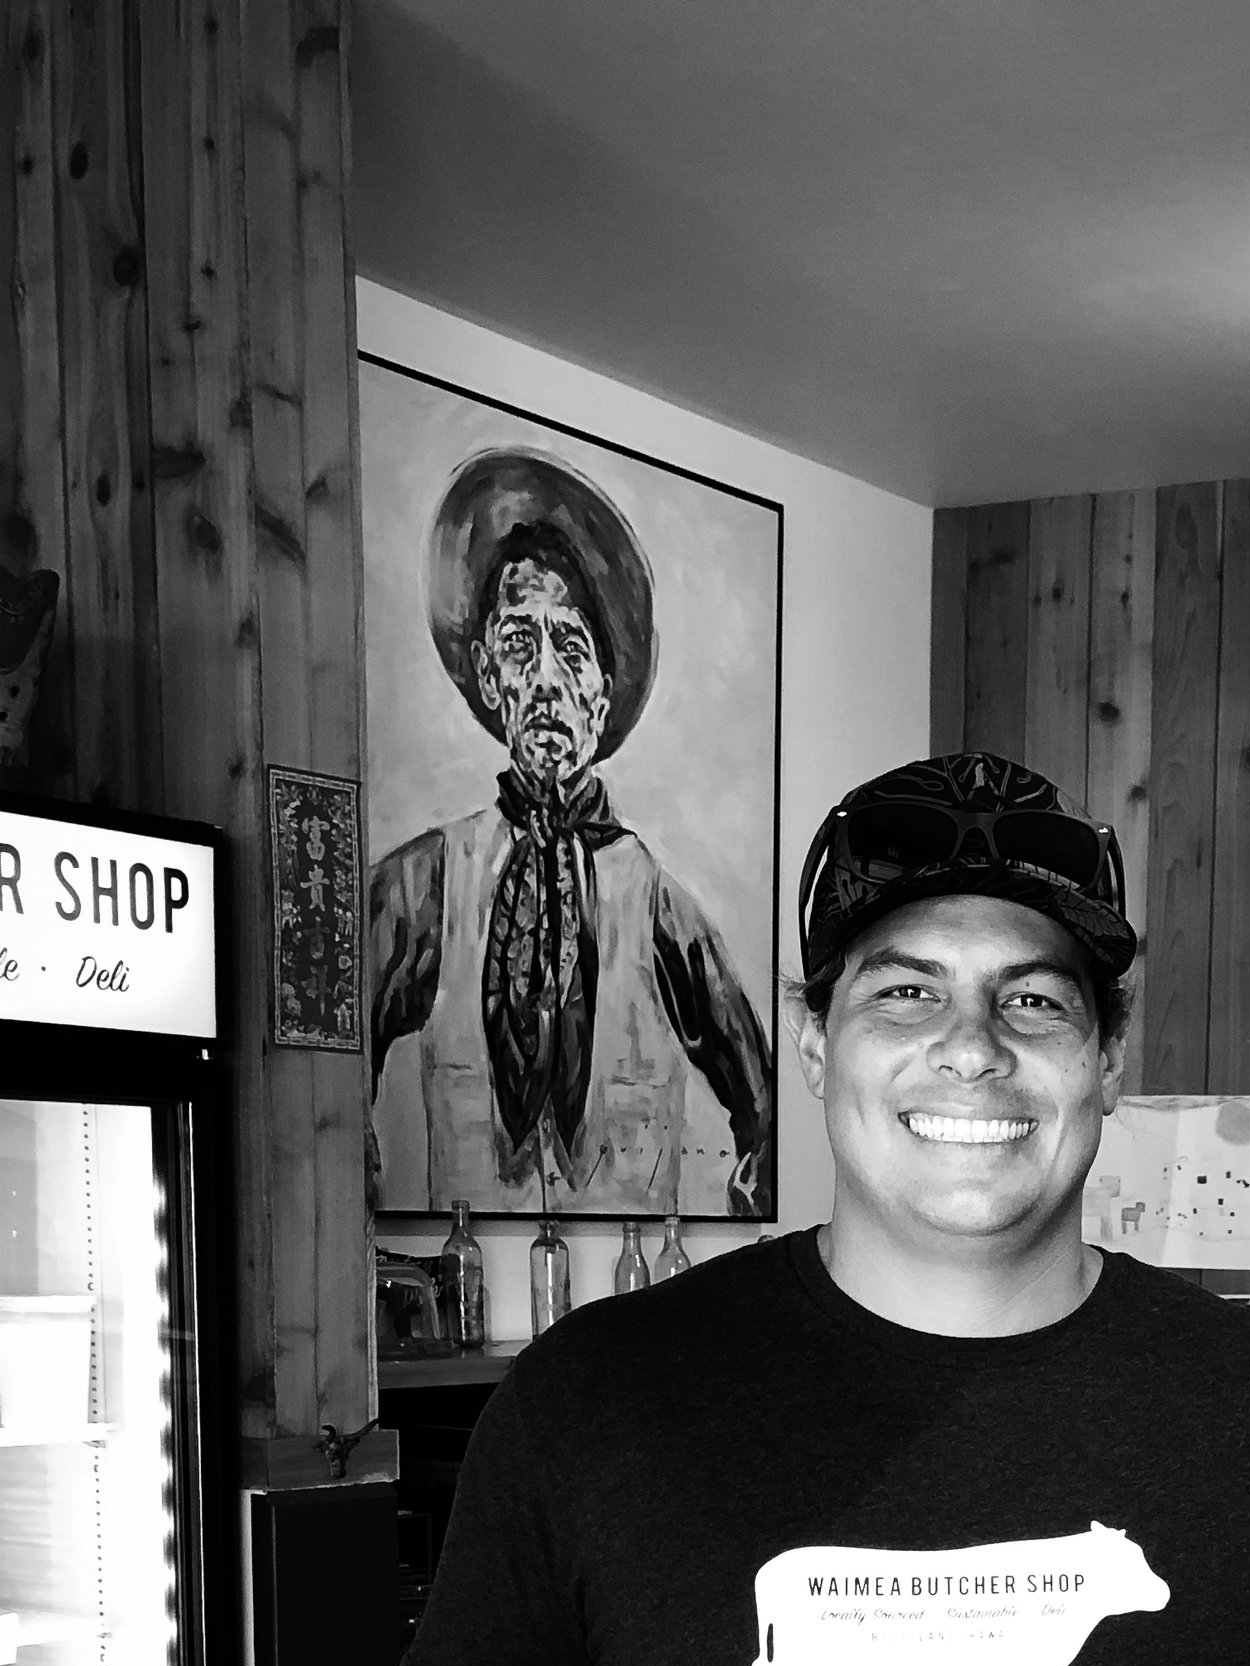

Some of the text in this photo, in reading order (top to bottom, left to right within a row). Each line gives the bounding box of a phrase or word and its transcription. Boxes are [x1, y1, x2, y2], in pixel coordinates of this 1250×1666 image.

[54, 851, 190, 934] SHOP
[75, 955, 131, 993] Deli
[808, 1574, 1086, 1597] WAIMEA BUTCHER SHOP
[820, 1603, 1067, 1626] Locally Sourced Sustainable Deli
